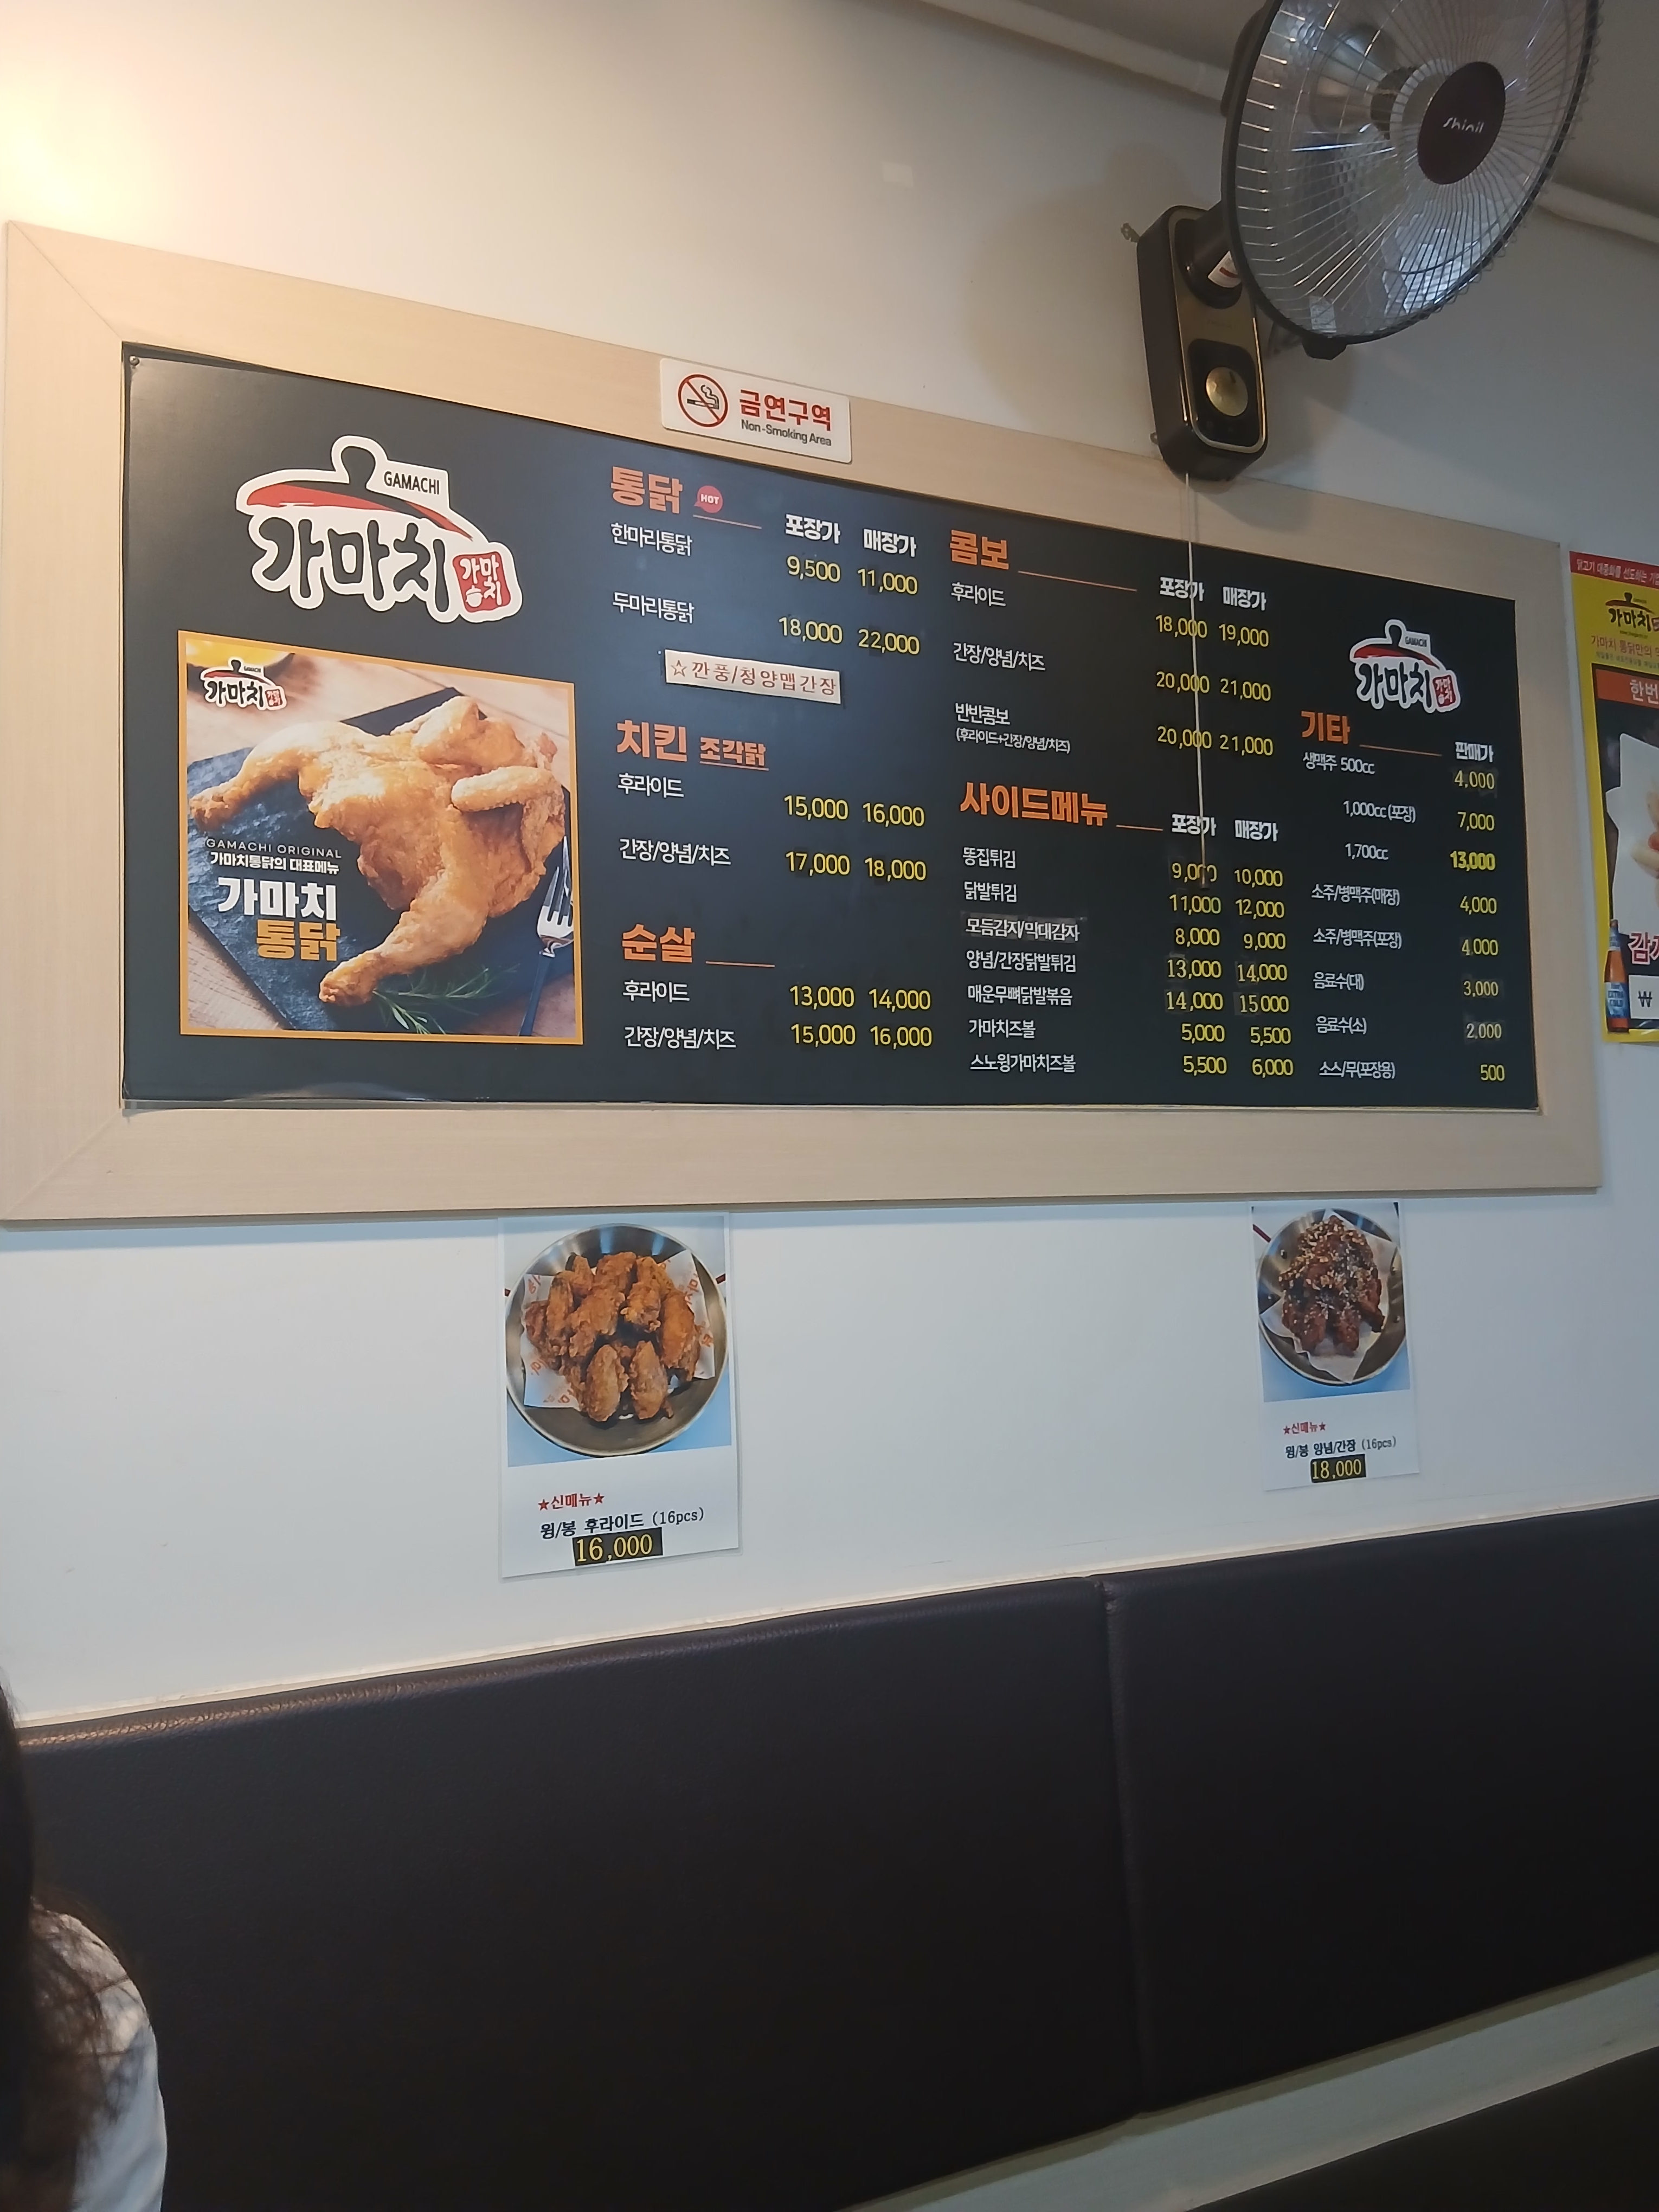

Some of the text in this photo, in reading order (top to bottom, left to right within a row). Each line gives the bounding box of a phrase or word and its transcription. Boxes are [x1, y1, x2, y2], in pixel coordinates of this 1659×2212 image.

[739, 389, 831, 432] 금연구역
[741, 420, 832, 447] Non-Smoking Area
[384, 471, 440, 495] GAMACHI
[610, 466, 683, 514] 통닭
[700, 493, 719, 506] HOT
[785, 513, 917, 558] 포장가 매장가
[950, 529, 1009, 570] 콤보
[259, 517, 449, 613] 가마치
[610, 522, 918, 595] 한마리통닭 9,500 11,000
[1160, 576, 1267, 611] 포장가 매장가
[613, 591, 920, 655] 두마리통닭 18,000 22,000
[951, 582, 1270, 648] 후라이드 18,000 19,000
[1608, 608, 1651, 632] 가마치
[1591, 635, 1617, 651] 가마치
[953, 642, 1271, 702] 간장/양념/치즈 20,000 21,000
[1358, 661, 1432, 708] 가마치
[207, 680, 263, 707] 가마치
[1630, 679, 1659, 705] 한번
[955, 703, 1274, 757] 반반콤보 20,000 21,000
[1301, 710, 1351, 744] 기타
[616, 719, 766, 767] 치킨 조각닭
[1455, 741, 1494, 763] 판매가
[1302, 751, 1495, 790] 생맥주 500cc 4,000
[618, 772, 925, 827] 후라이드 15,000 16,000
[960, 782, 1108, 826] 사이드메뉴
[1172, 814, 1278, 842] 포장가 매장가
[1343, 800, 1495, 831] 1,000cc (포장) 7,000
[205, 838, 342, 858] GAMACHI ORIGINAL
[210, 851, 339, 874] 가마치통닭의 대표메뉴
[619, 838, 927, 883] 간장/양념/치즈 17,000 18,000
[1345, 843, 1496, 872] 1,700cc 13,000
[962, 847, 1016, 869] 똥집튀김
[1234, 869, 1283, 888] 10,000
[217, 877, 337, 921] 가마치
[964, 881, 1285, 919] 닭발튀김 11,000 12,000
[1311, 884, 1497, 915] 소주/병맥주(매장) 4,000
[256, 919, 341, 961] 통닭
[622, 923, 696, 963] 순살
[1175, 927, 1220, 947] 8,000
[1243, 932, 1287, 951] 9,000
[1313, 928, 1403, 949] 소주/병맥주(포장)
[966, 949, 1288, 982] 양념/간장닭발튀김 13,000 14,000
[622, 979, 931, 1013] 후라이드 13,000 14,000
[967, 985, 1073, 1006] 매운무뼈닭발볶음
[1166, 991, 1224, 1012] 14,000
[1313, 971, 1499, 998] 음료수(대) 3,000
[624, 1024, 933, 1050] 간장/양념/치즈 15,000 16,000
[969, 1019, 1291, 1046] 가마치즈볼 5,000 5,500
[1315, 1015, 1502, 1040] 음료수(소) 2,000
[970, 1053, 1294, 1078] 스노윙가마치즈볼 5,500 6,000
[1319, 1060, 1506, 1082] 소스/무(포장용) 500
[1361, 1435, 1397, 1451] (16pcs)
[1312, 1458, 1362, 1480] 18,000
[584, 1513, 645, 1534] 후라이드
[653, 1507, 705, 1527] (16pcs)
[576, 1534, 653, 1562] 16,000
